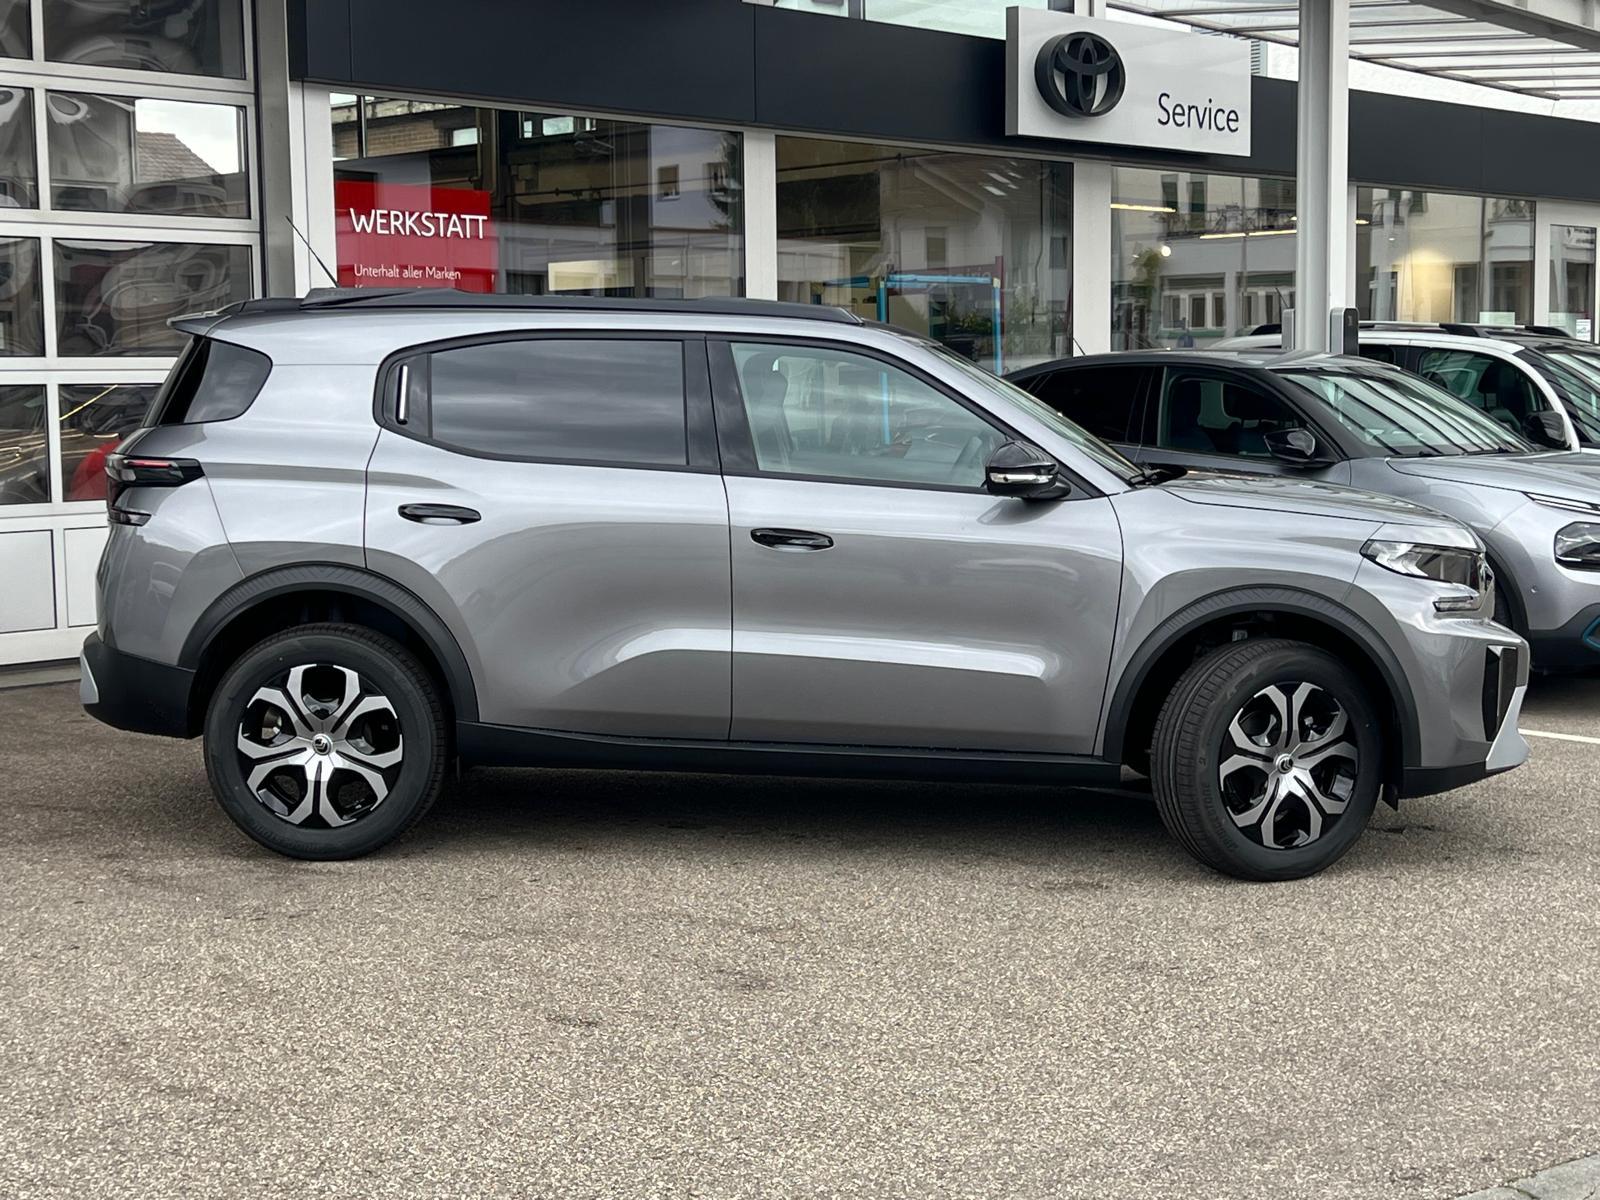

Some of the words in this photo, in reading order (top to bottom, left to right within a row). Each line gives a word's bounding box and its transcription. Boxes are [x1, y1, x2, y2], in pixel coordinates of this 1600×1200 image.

[1158, 93, 1239, 133] Service
[350, 208, 488, 239] WERKSTATT
[354, 264, 400, 278] Unterhalt
[402, 265, 422, 279] aller
[425, 266, 461, 280] Marken
